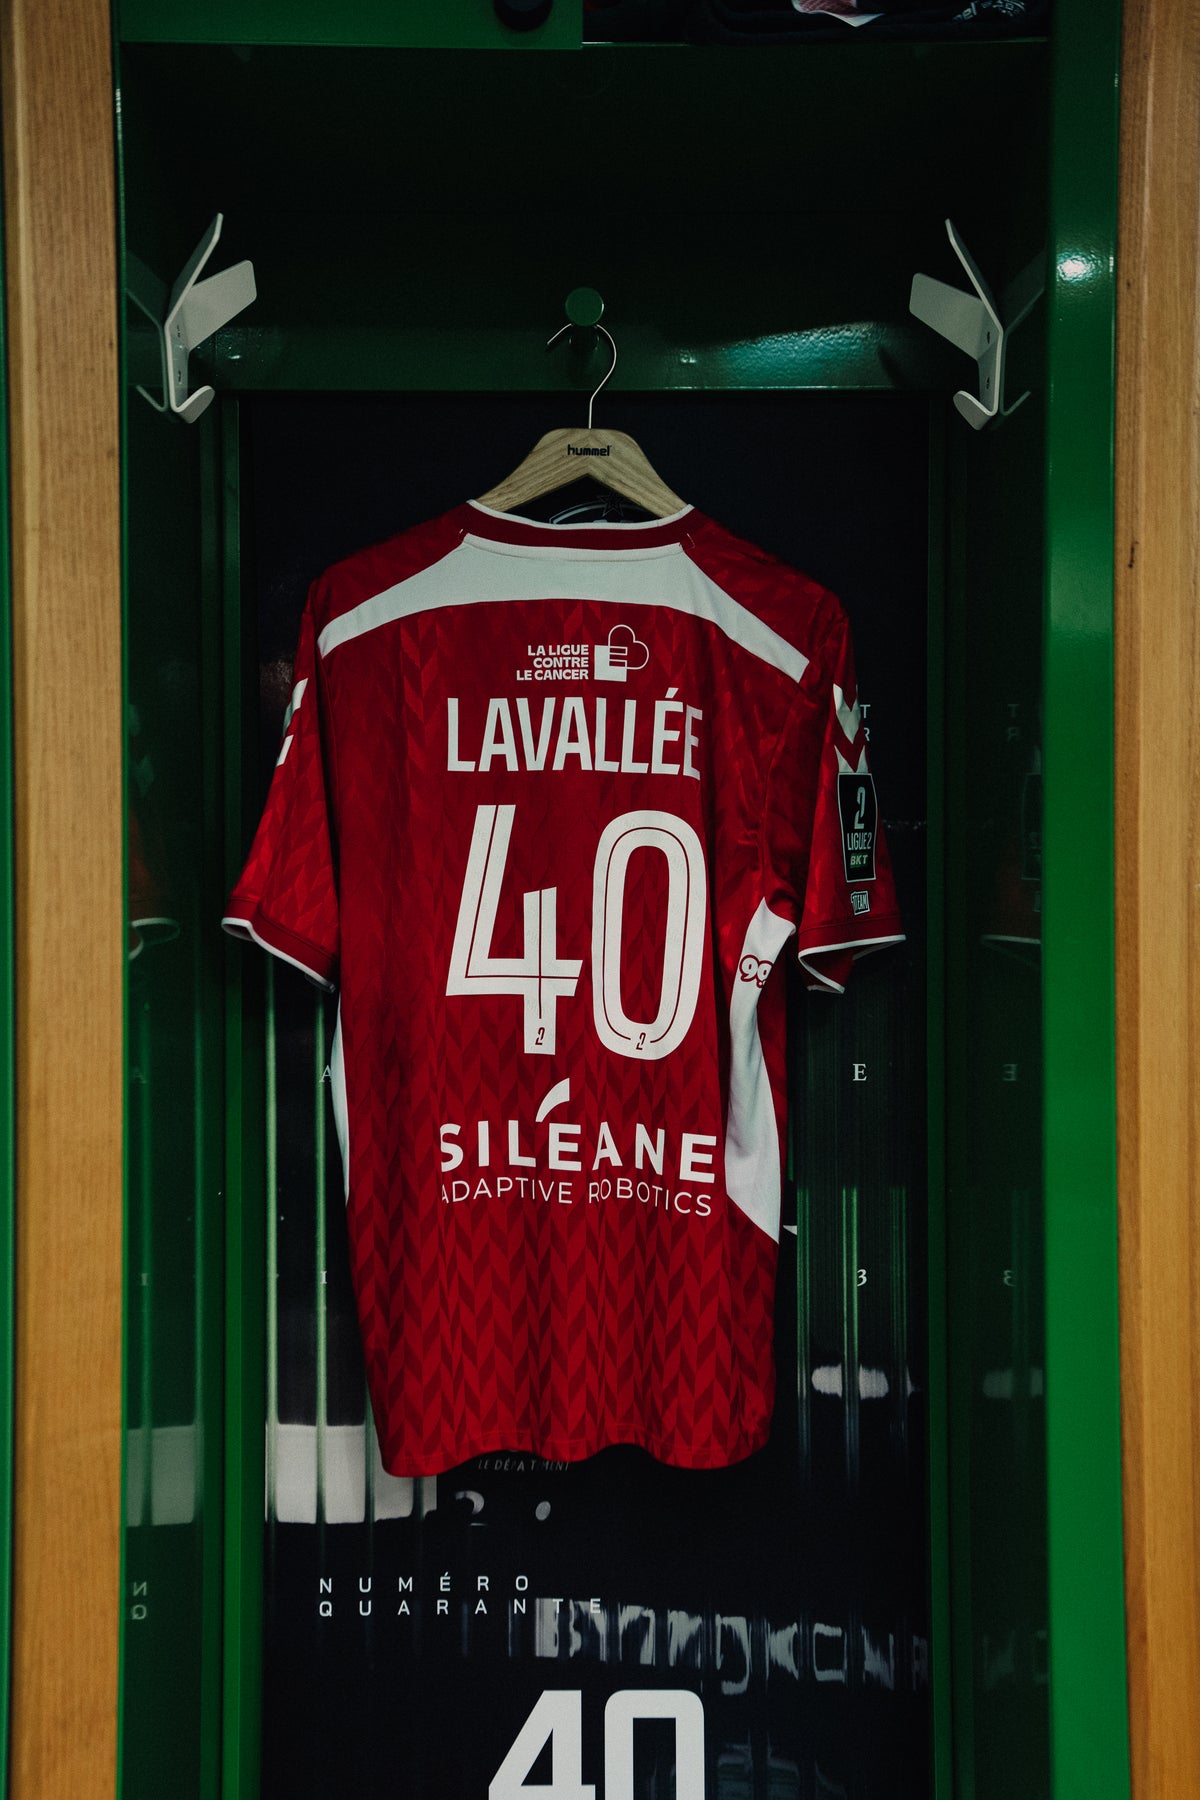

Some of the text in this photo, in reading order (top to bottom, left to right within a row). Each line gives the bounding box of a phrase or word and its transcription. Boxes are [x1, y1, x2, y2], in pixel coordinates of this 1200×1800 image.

[567, 444, 610, 457] hummel
[527, 644, 589, 657] LA LIGUE
[533, 657, 589, 668] CONTRE
[516, 669, 589, 681] LE CANCER
[447, 687, 703, 780] LAVALLÉE
[850, 854, 868, 866] BKT
[445, 804, 707, 1060] 40
[852, 1063, 867, 1081] E
[439, 1077, 717, 1184] SILÉANE
[441, 1176, 712, 1218] ADAPTIVE ROBOTICS
[318, 1571, 529, 1594] NUMÉRO
[318, 1598, 601, 1617] QUARANTE
[487, 1689, 705, 1800] 40
